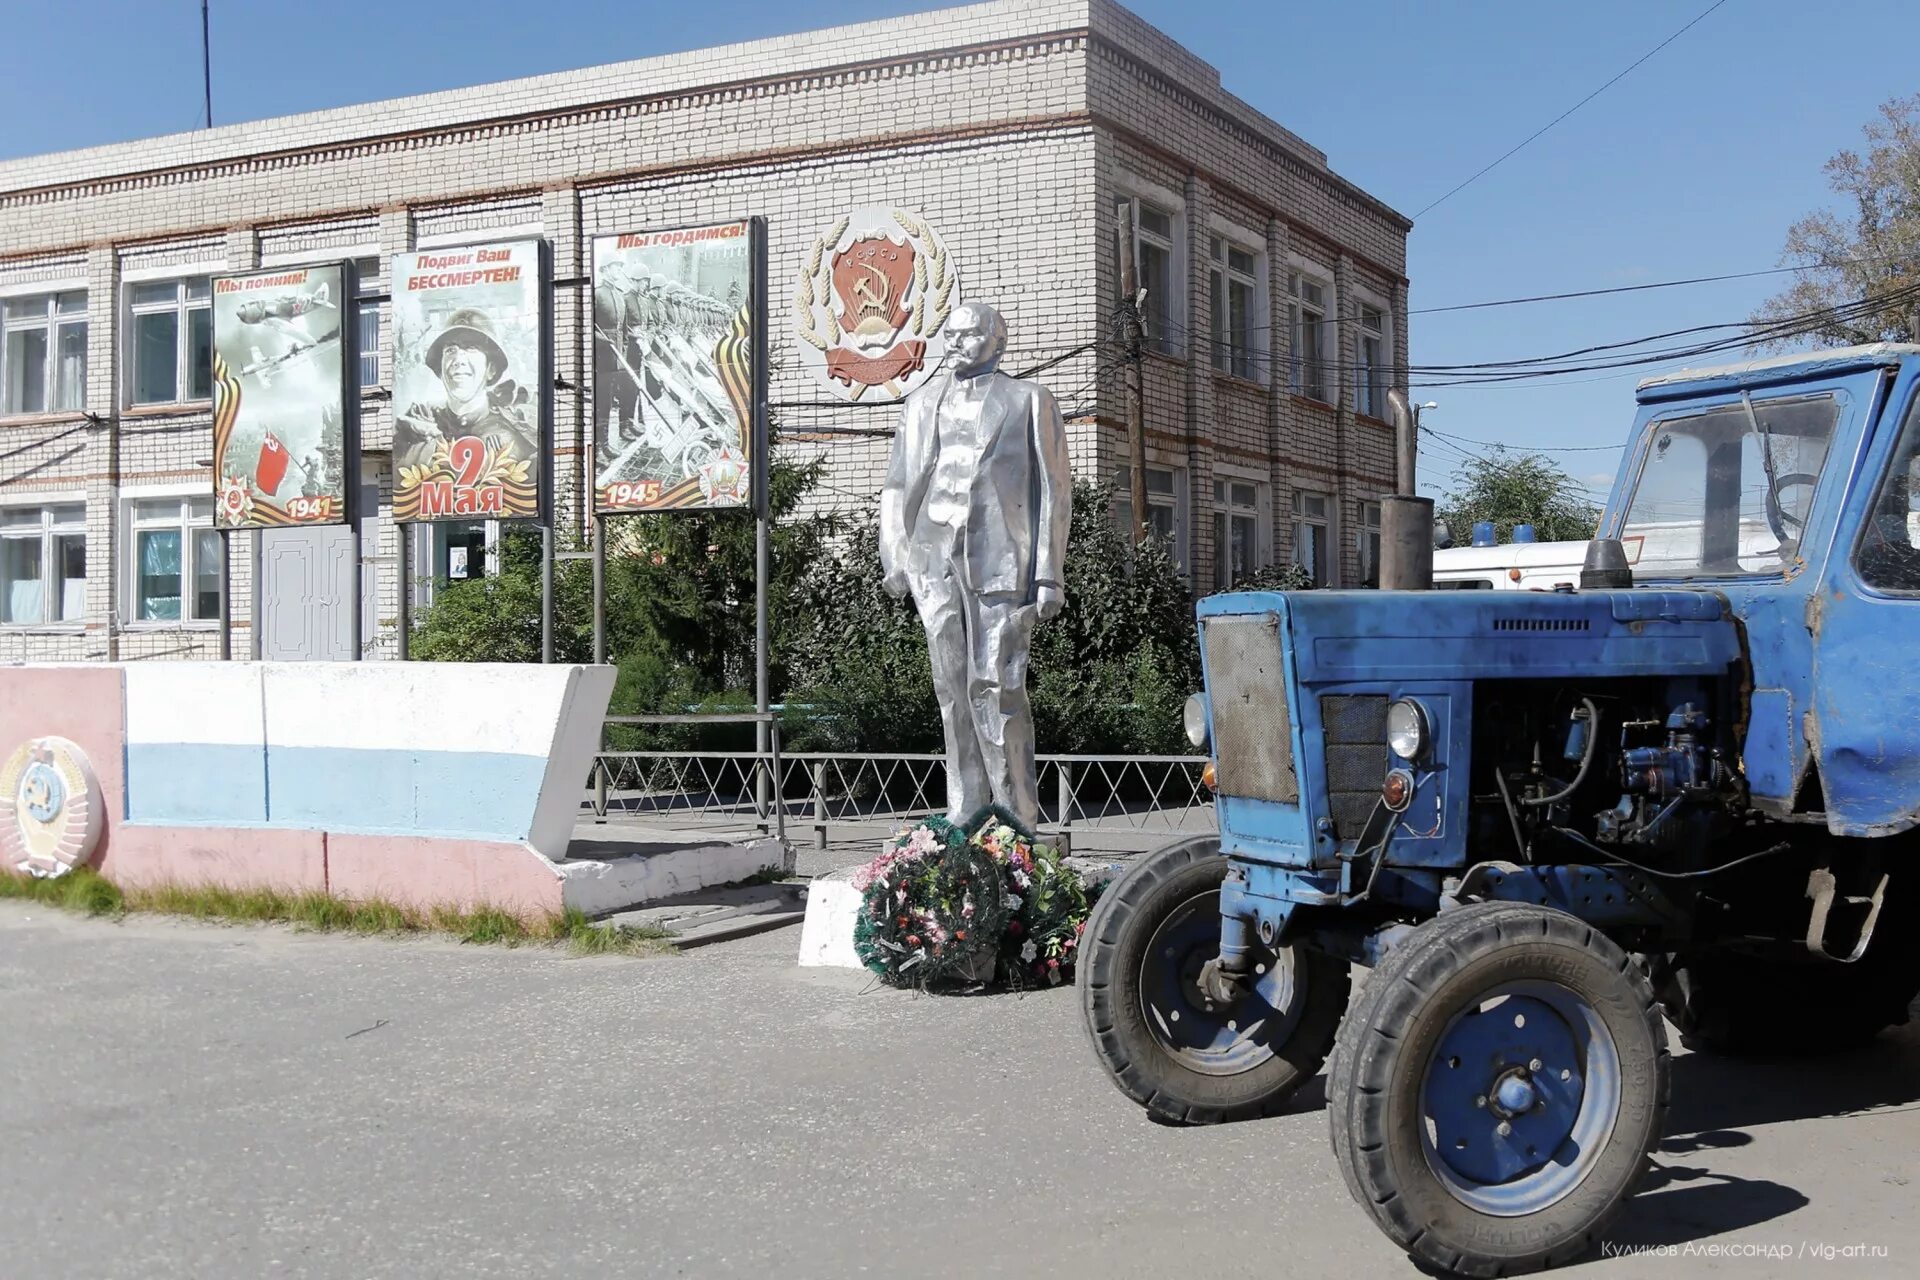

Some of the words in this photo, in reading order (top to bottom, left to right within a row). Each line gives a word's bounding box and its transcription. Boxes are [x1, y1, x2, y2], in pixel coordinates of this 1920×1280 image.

[615, 232, 650, 249] Мы
[652, 220, 748, 247] гордимся!
[417, 253, 474, 270] Подвиг
[476, 248, 512, 263] Ваш
[216, 278, 242, 294] Мы
[245, 267, 309, 290] помним!
[408, 266, 521, 291] БЕССМЕРТЕН!
[449, 435, 487, 488] 9
[420, 481, 504, 516] Мая
[607, 483, 660, 504] 1945
[287, 498, 331, 517] 1941
